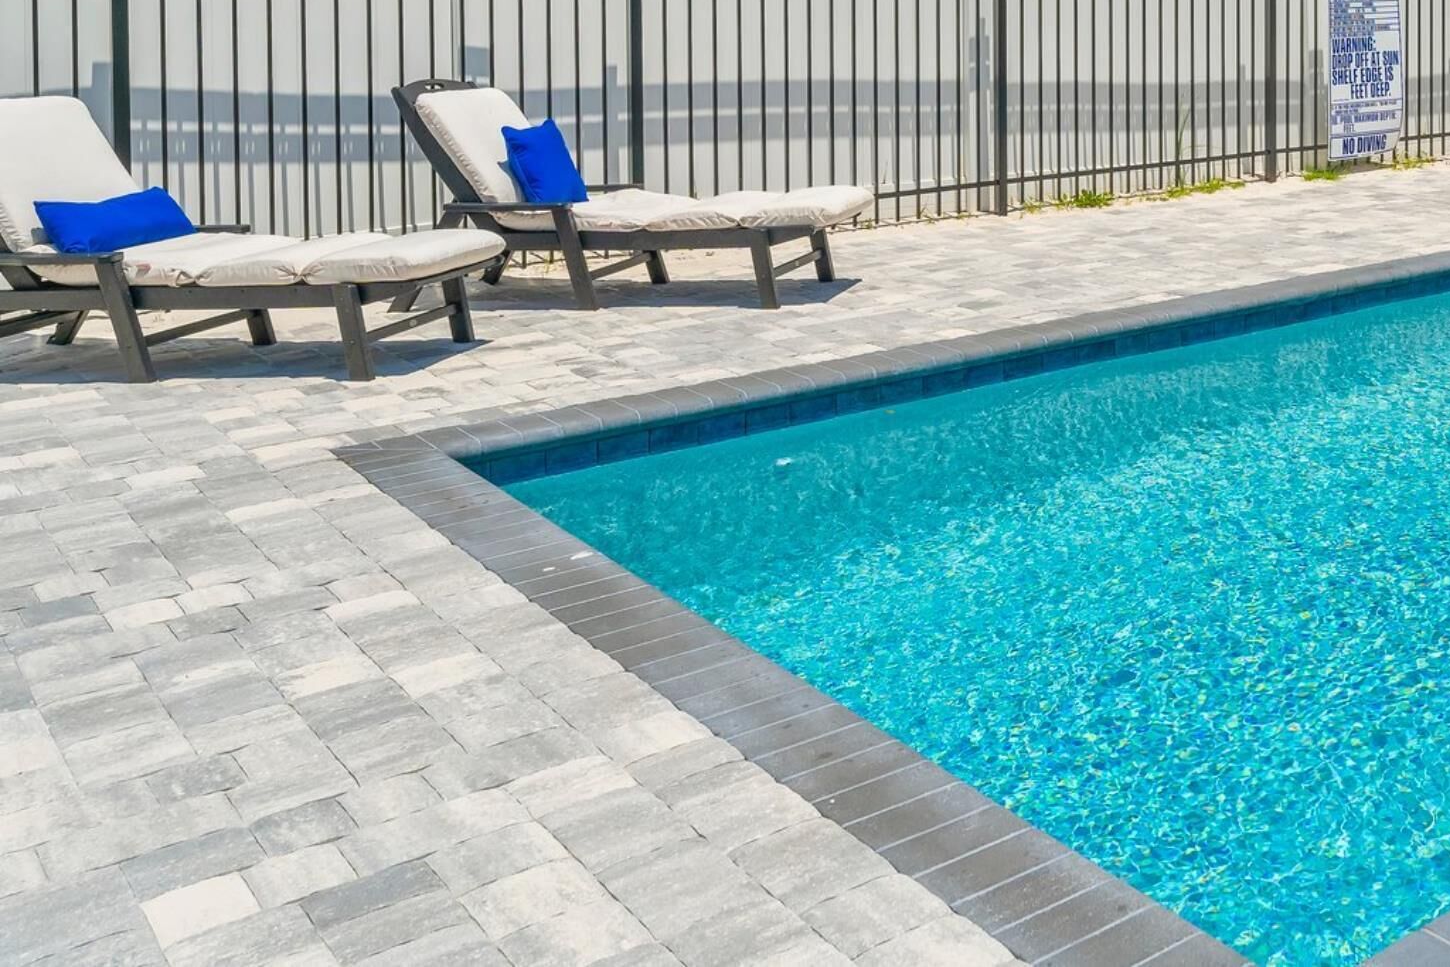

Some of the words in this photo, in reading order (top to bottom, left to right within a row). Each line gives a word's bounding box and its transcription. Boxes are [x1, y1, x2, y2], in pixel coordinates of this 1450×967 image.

[1332, 37, 1376, 53] WARNING:
[1332, 53, 1353, 69] DROP
[1354, 52, 1369, 68] OFF
[1371, 52, 1380, 67] AT
[1382, 50, 1399, 65] SUN
[1332, 68, 1358, 86] SHELF
[1360, 67, 1383, 83] EDGE
[1384, 65, 1394, 81] IS
[1350, 83, 1369, 99] FEET
[1370, 81, 1391, 98] DEEP.
[1342, 137, 1355, 155] NO
[1357, 134, 1387, 153] DIVING
